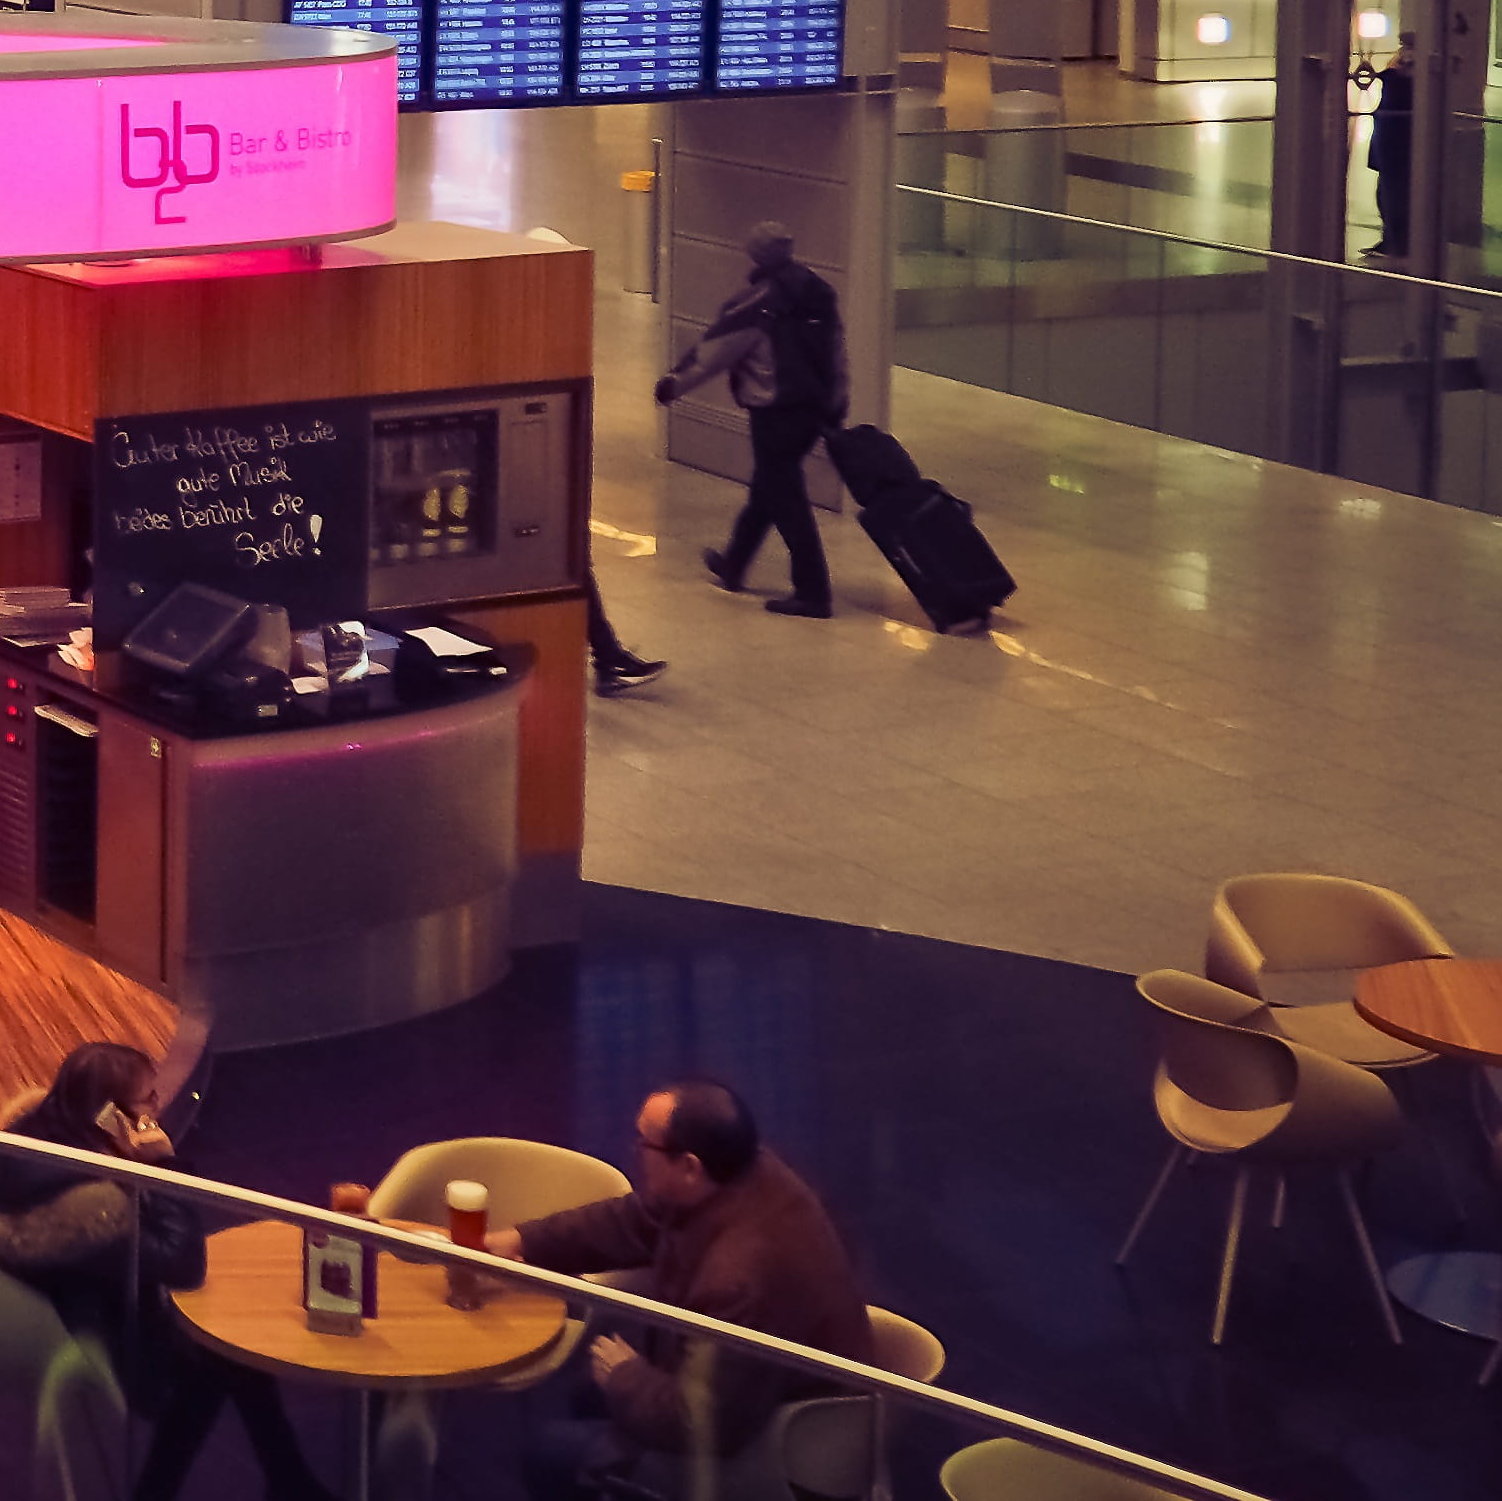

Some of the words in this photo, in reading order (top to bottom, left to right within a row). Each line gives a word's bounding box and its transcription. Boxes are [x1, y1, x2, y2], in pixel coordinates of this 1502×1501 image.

[230, 132, 267, 155] Bar
[275, 129, 287, 151] &
[298, 127, 351, 151] Bistro
[113, 430, 179, 468] Guter
[185, 426, 259, 463] Kaffee
[265, 423, 295, 450] ist
[298, 419, 337, 444] wie
[177, 468, 220, 507] gute
[229, 456, 293, 486] Musik
[271, 494, 304, 516] die
